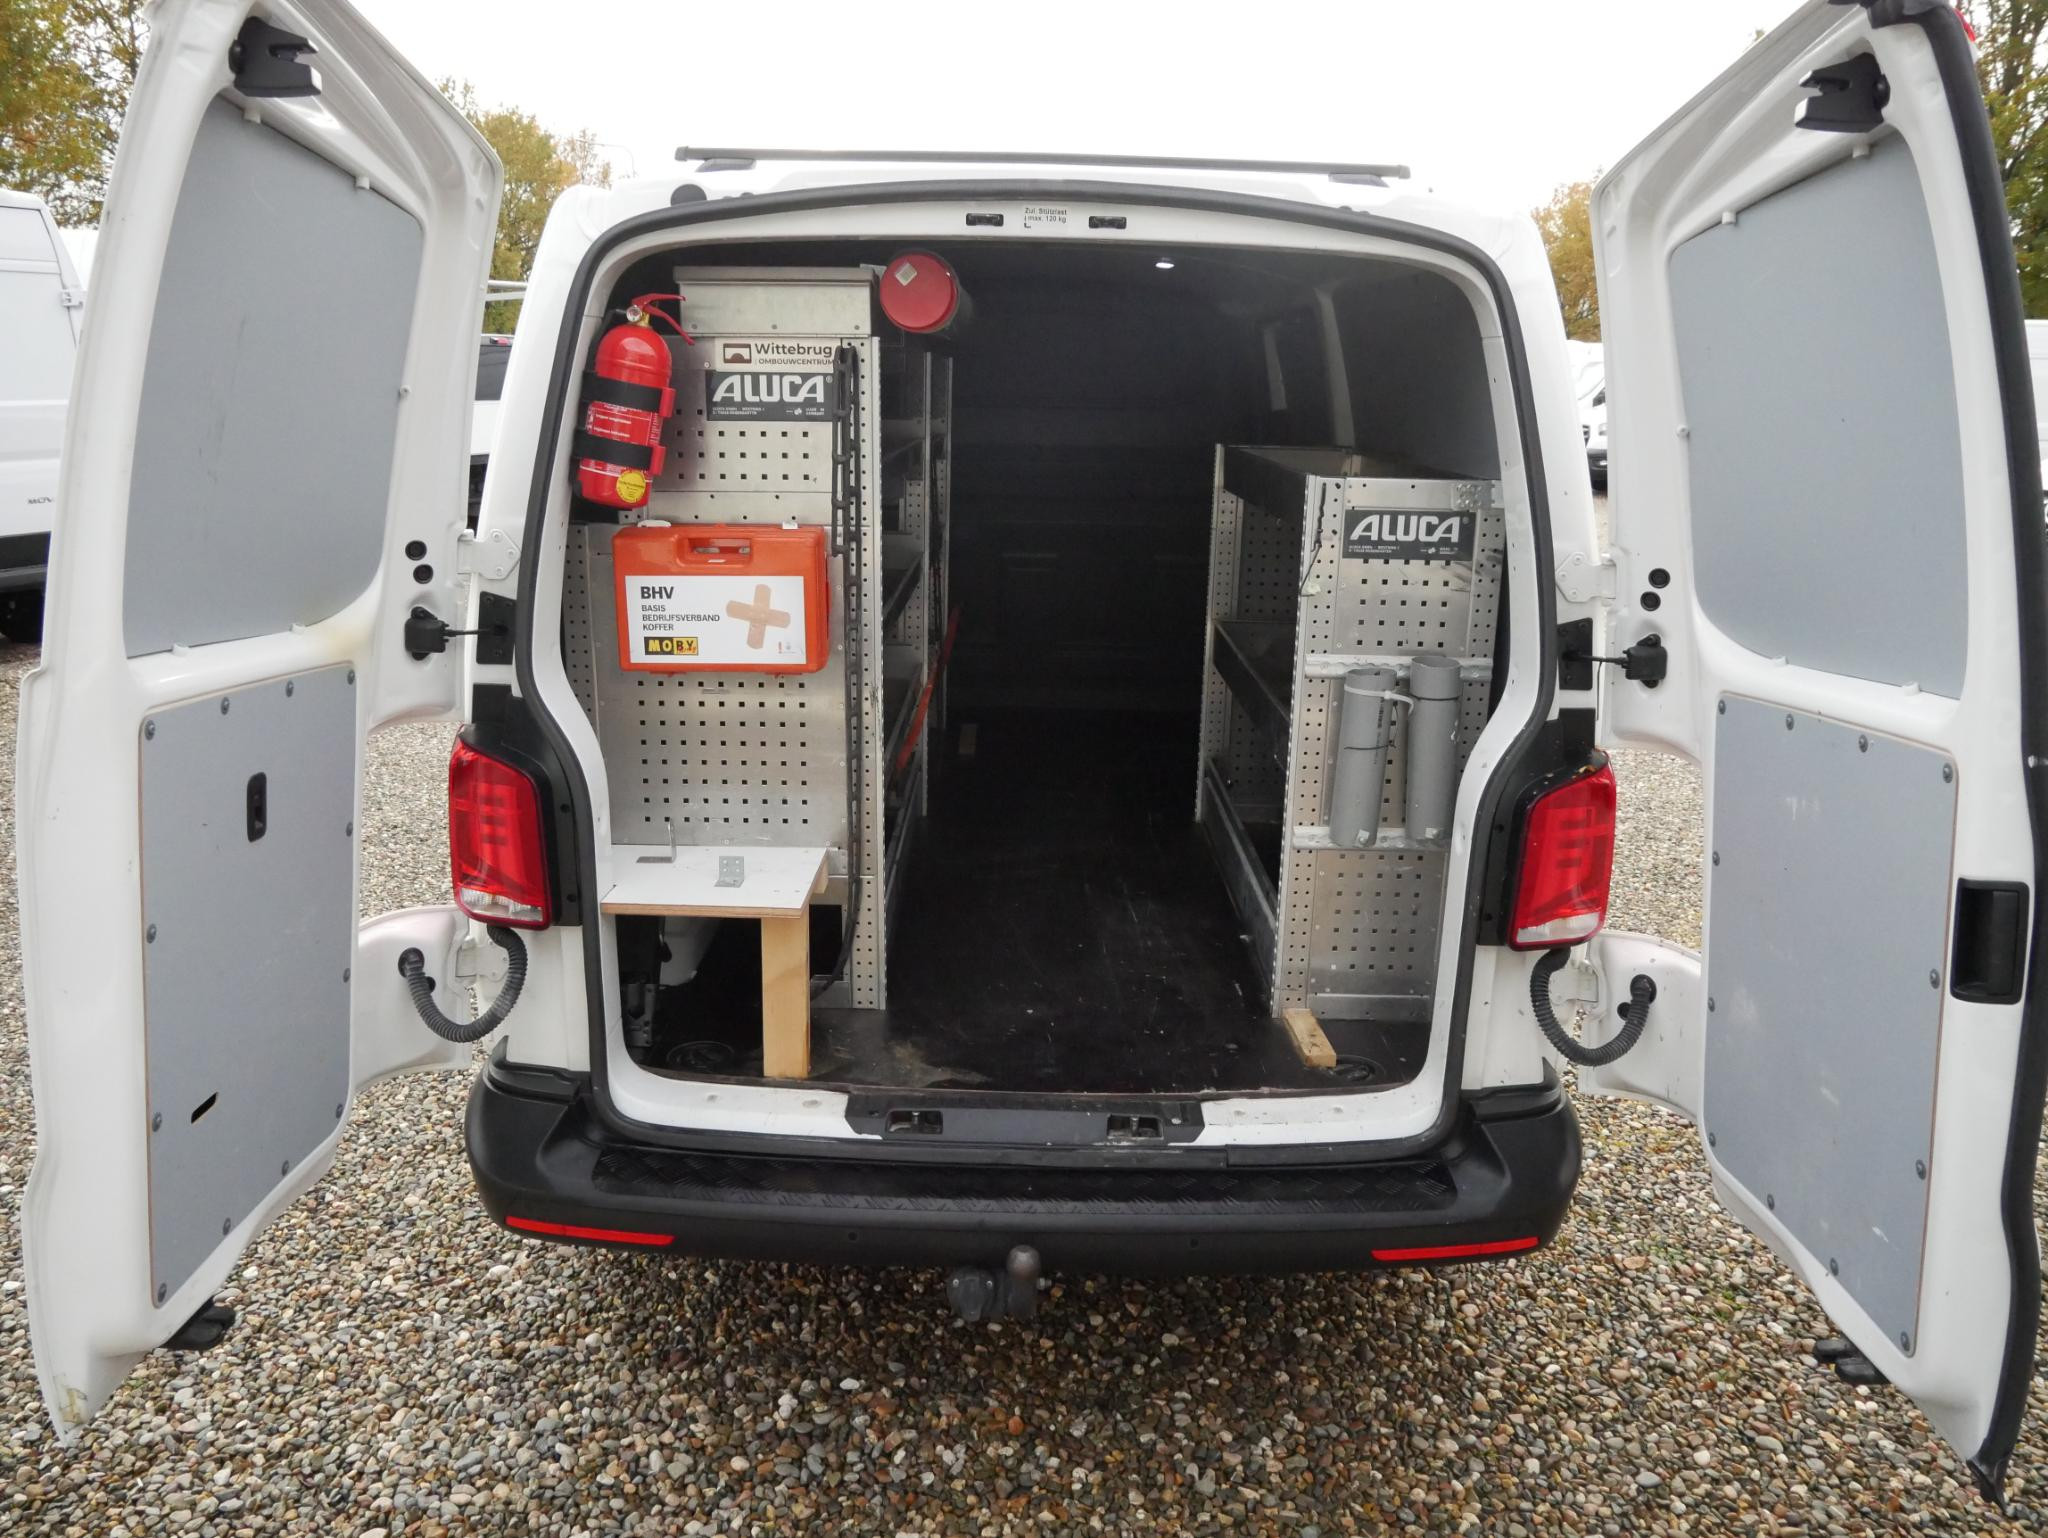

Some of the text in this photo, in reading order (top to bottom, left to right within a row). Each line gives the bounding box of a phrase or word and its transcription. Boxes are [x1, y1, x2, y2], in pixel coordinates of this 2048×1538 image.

[1058, 216, 1067, 224] kg
[755, 342, 832, 358] Wittebrug
[712, 374, 825, 403] ALUCA
[1350, 514, 1460, 543] ALUCA
[640, 586, 674, 600] BHV
[641, 604, 666, 612] BASIS
[642, 614, 721, 622] BEDRIJFSVERBAND
[642, 623, 674, 631] KOFFER
[648, 639, 695, 652] MOBY
